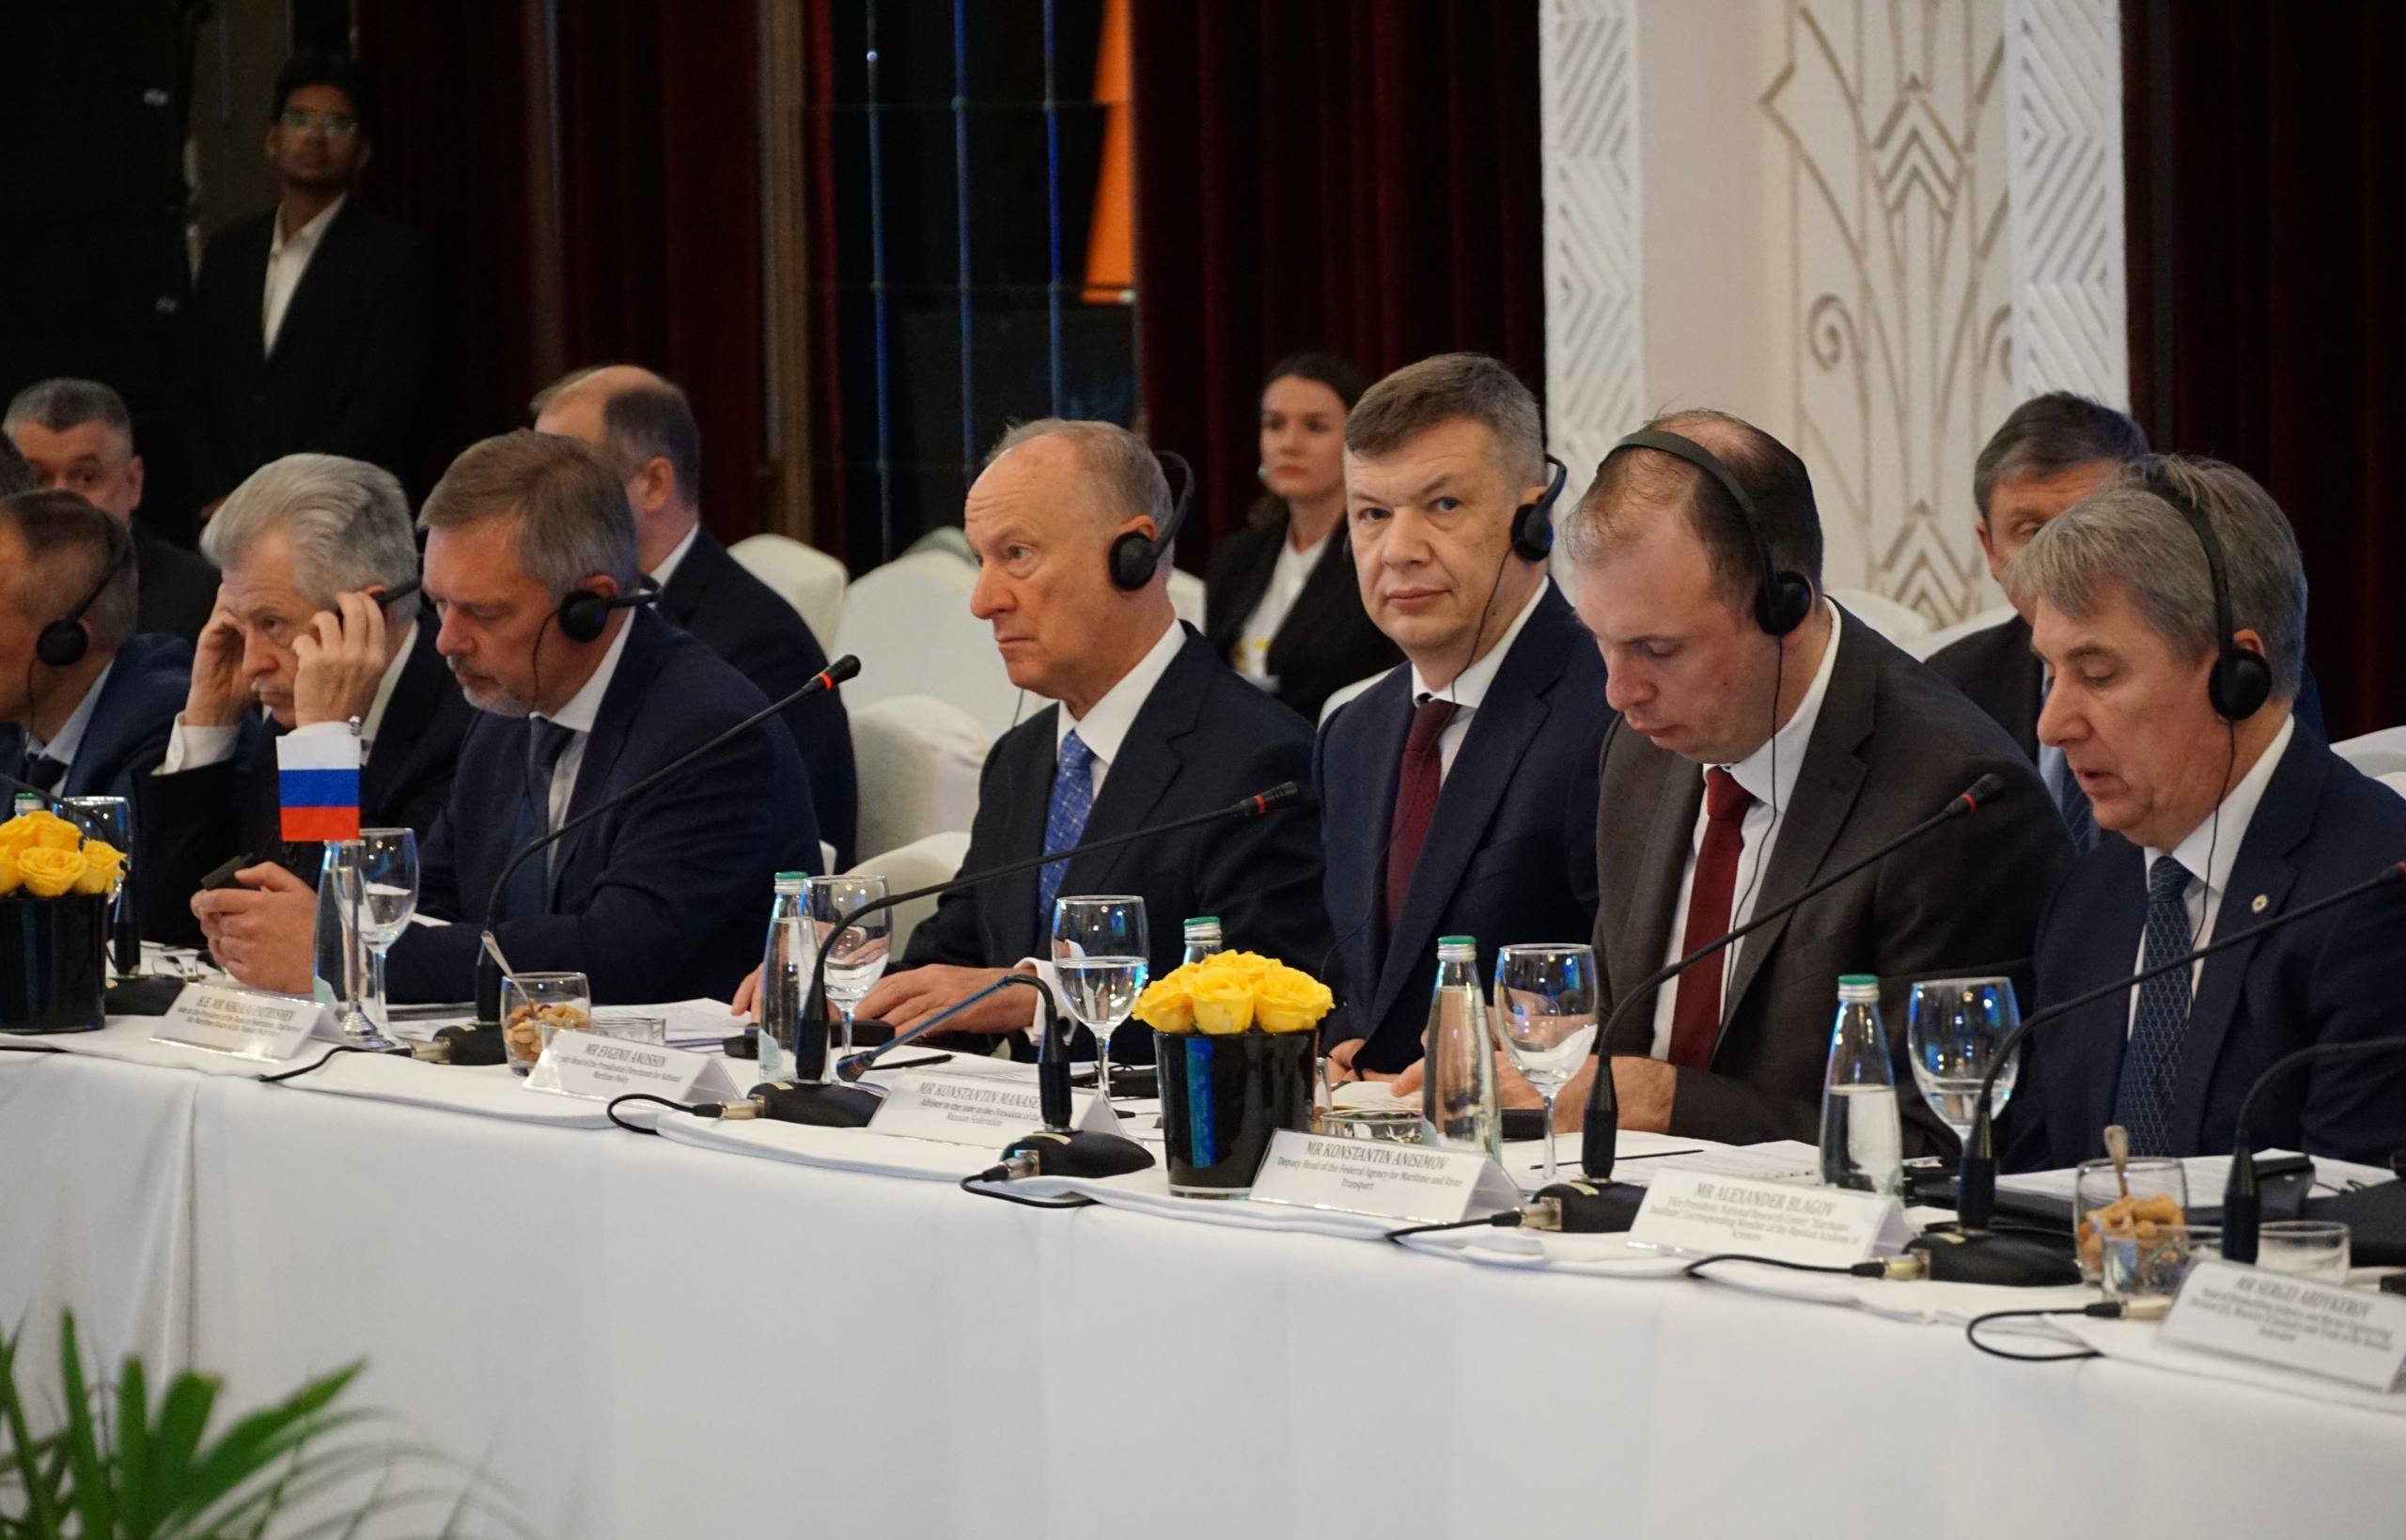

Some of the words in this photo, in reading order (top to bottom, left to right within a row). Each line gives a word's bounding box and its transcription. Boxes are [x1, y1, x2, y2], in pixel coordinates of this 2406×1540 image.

[586, 1044, 599, 1056] MR
[919, 1082, 936, 1096] MR
[936, 1085, 1000, 1103] KONSTANTIN
[1000, 1093, 1039, 1109] MANASE
[1305, 1142, 1322, 1156] MR
[1323, 1143, 1393, 1164] KONSTANTIN
[1393, 1152, 1450, 1172] ANISIMOV
[1277, 1157, 1301, 1170] Deputy
[1304, 1160, 1319, 1170] Head
[1328, 1163, 1338, 1173] the
[1340, 1165, 1363, 1175] Federal
[1366, 1168, 1387, 1181] Agency
[1389, 1171, 1400, 1180] for
[1401, 1173, 1430, 1184] Maritime
[1432, 1176, 1445, 1186] and
[1342, 1178, 1374, 1191] Transport
[1695, 1182, 1716, 1200] MR
[1717, 1186, 1787, 1210] ALEXANDER
[1787, 1196, 1838, 1218] BLAGOV
